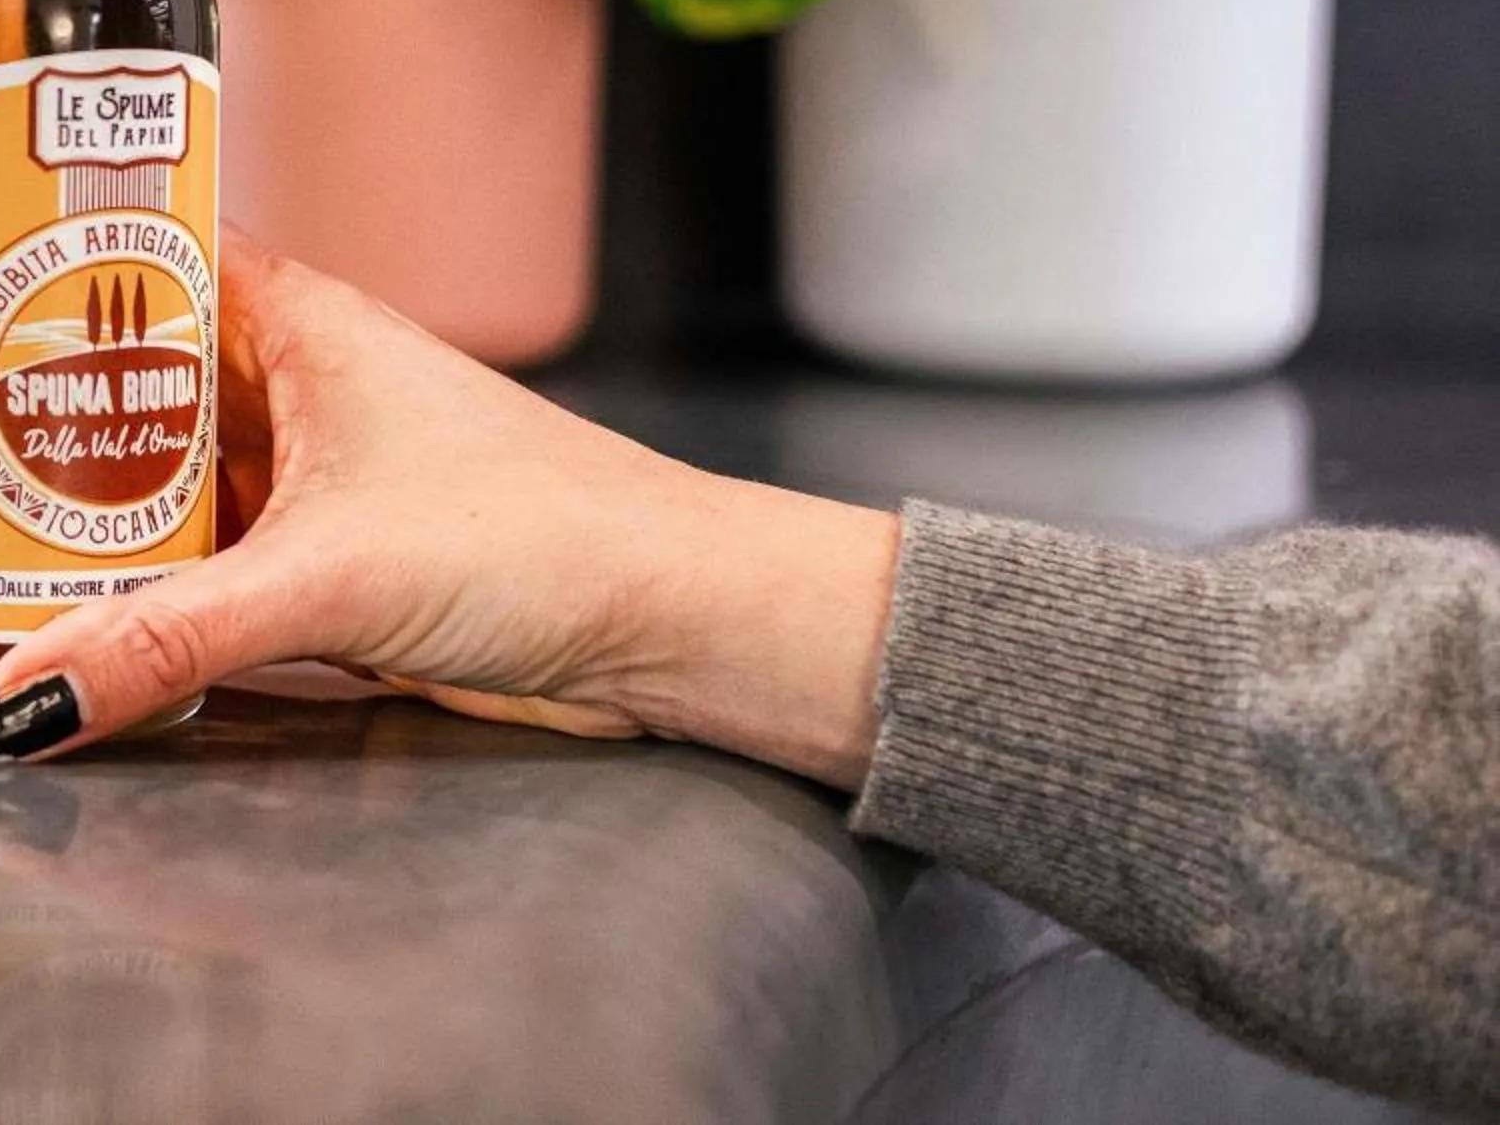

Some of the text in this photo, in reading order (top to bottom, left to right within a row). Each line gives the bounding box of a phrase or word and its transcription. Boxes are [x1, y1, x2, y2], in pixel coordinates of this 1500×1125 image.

[57, 86, 175, 121] LE SPUME
[58, 123, 174, 148] DEL PAPINI
[84, 222, 209, 304] ARTIGIANALE
[7, 362, 197, 417] SPUMA BIONDA
[20, 424, 88, 466] Della
[91, 424, 129, 460] Val
[45, 495, 173, 544] TOSCANA
[50, 579, 105, 597] NOSTRE
